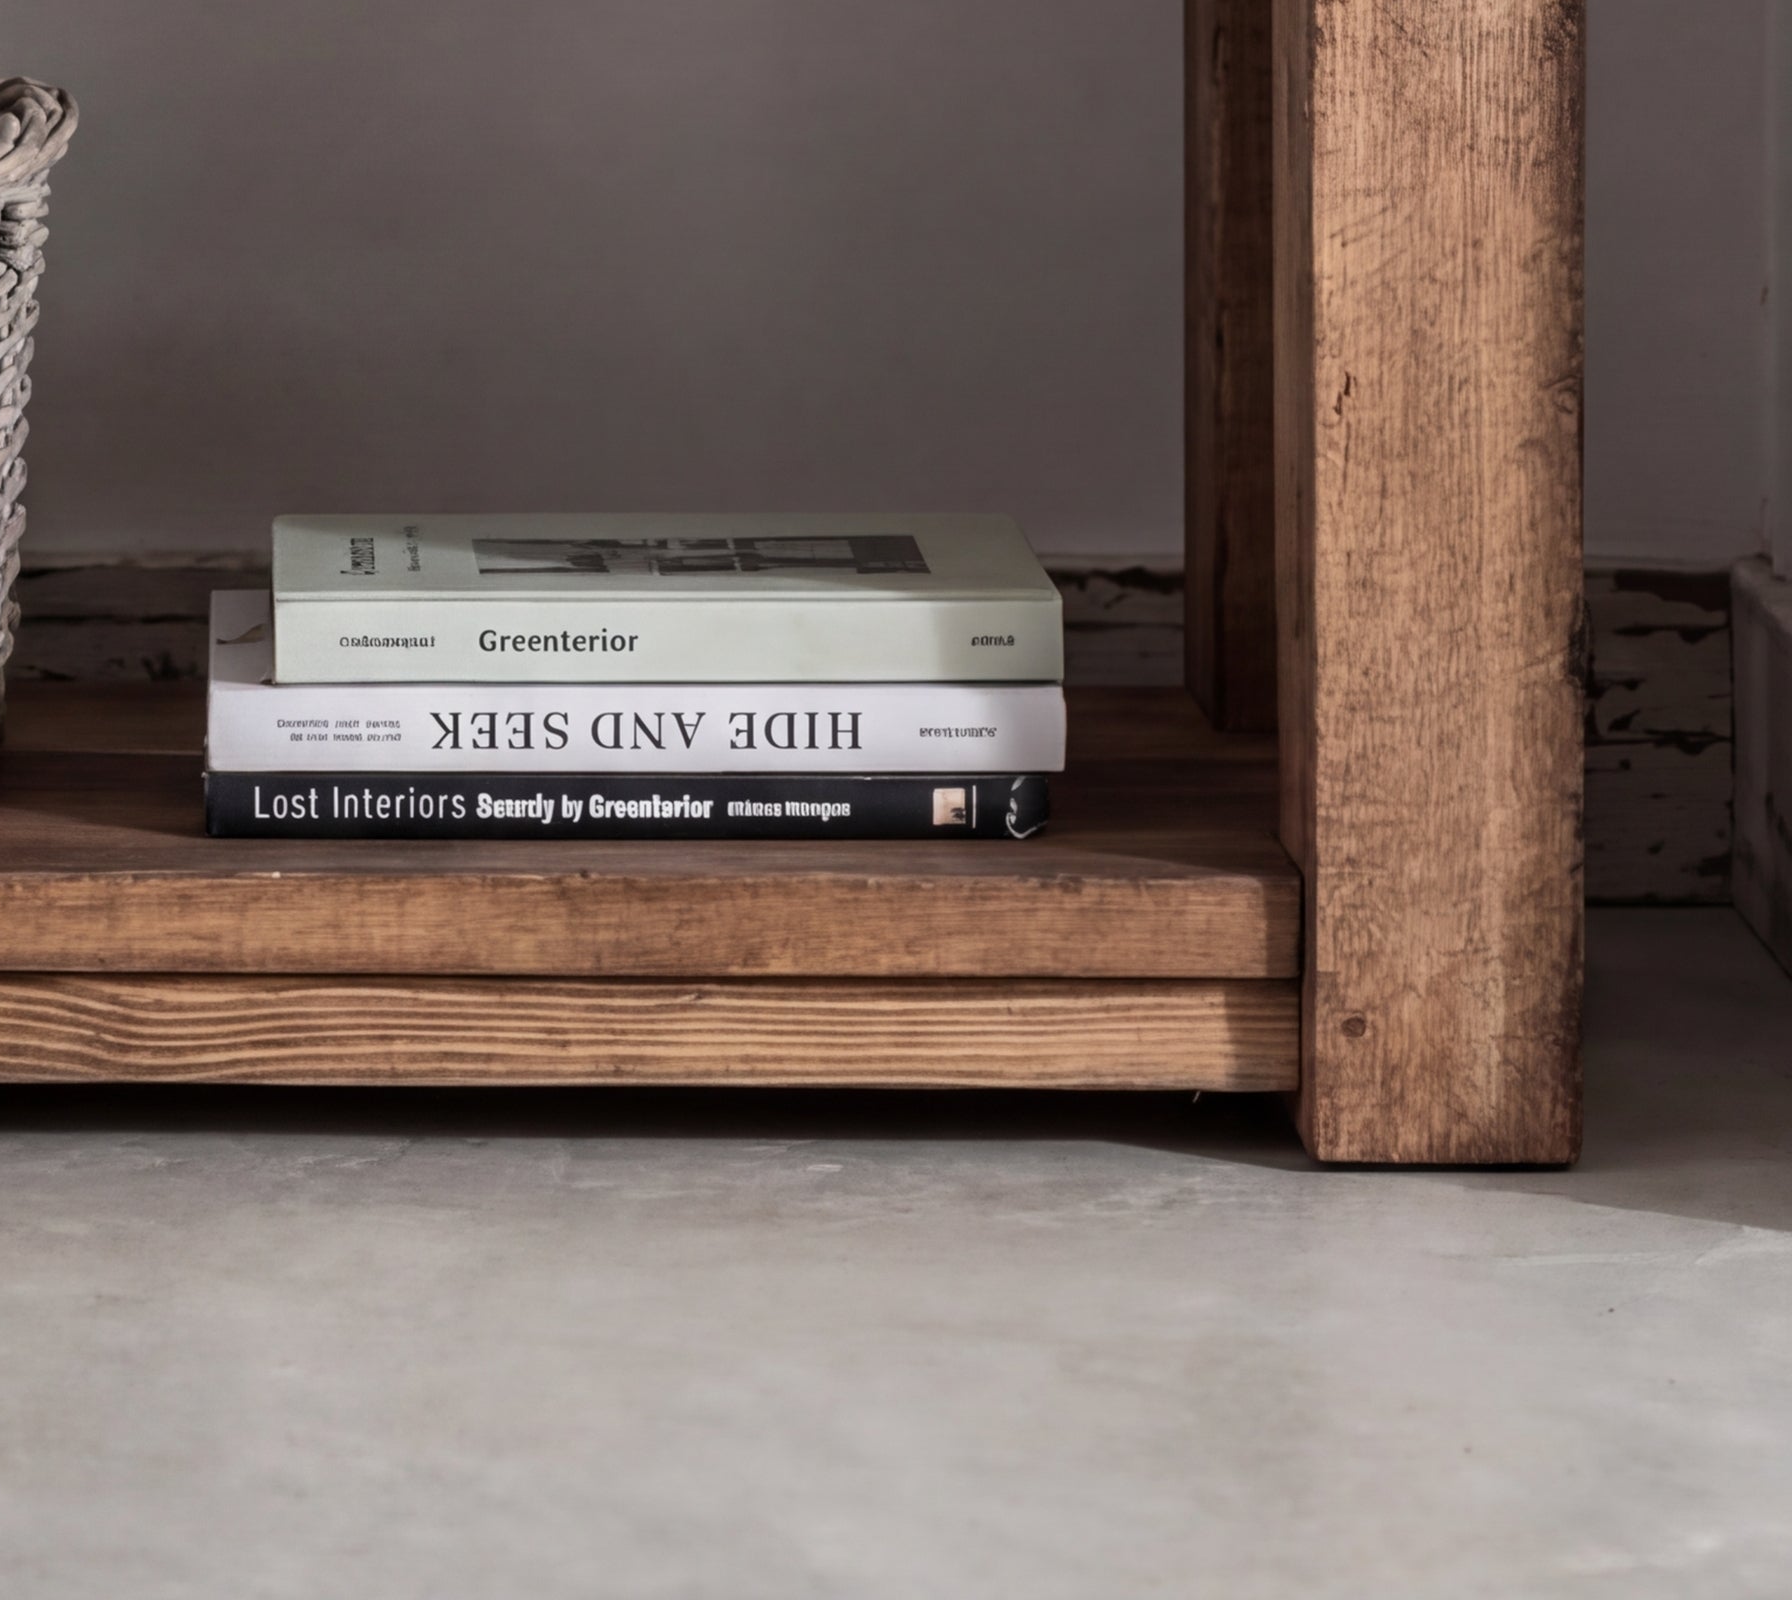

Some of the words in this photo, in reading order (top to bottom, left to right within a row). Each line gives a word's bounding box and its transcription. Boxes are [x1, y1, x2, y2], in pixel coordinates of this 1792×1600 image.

[478, 627, 639, 652] Greenterior
[429, 711, 570, 750] SEEK
[590, 711, 707, 750] AND
[728, 711, 863, 750] HIDE
[254, 785, 320, 819] Lost
[332, 785, 467, 819] Interiors
[561, 793, 585, 823] by
